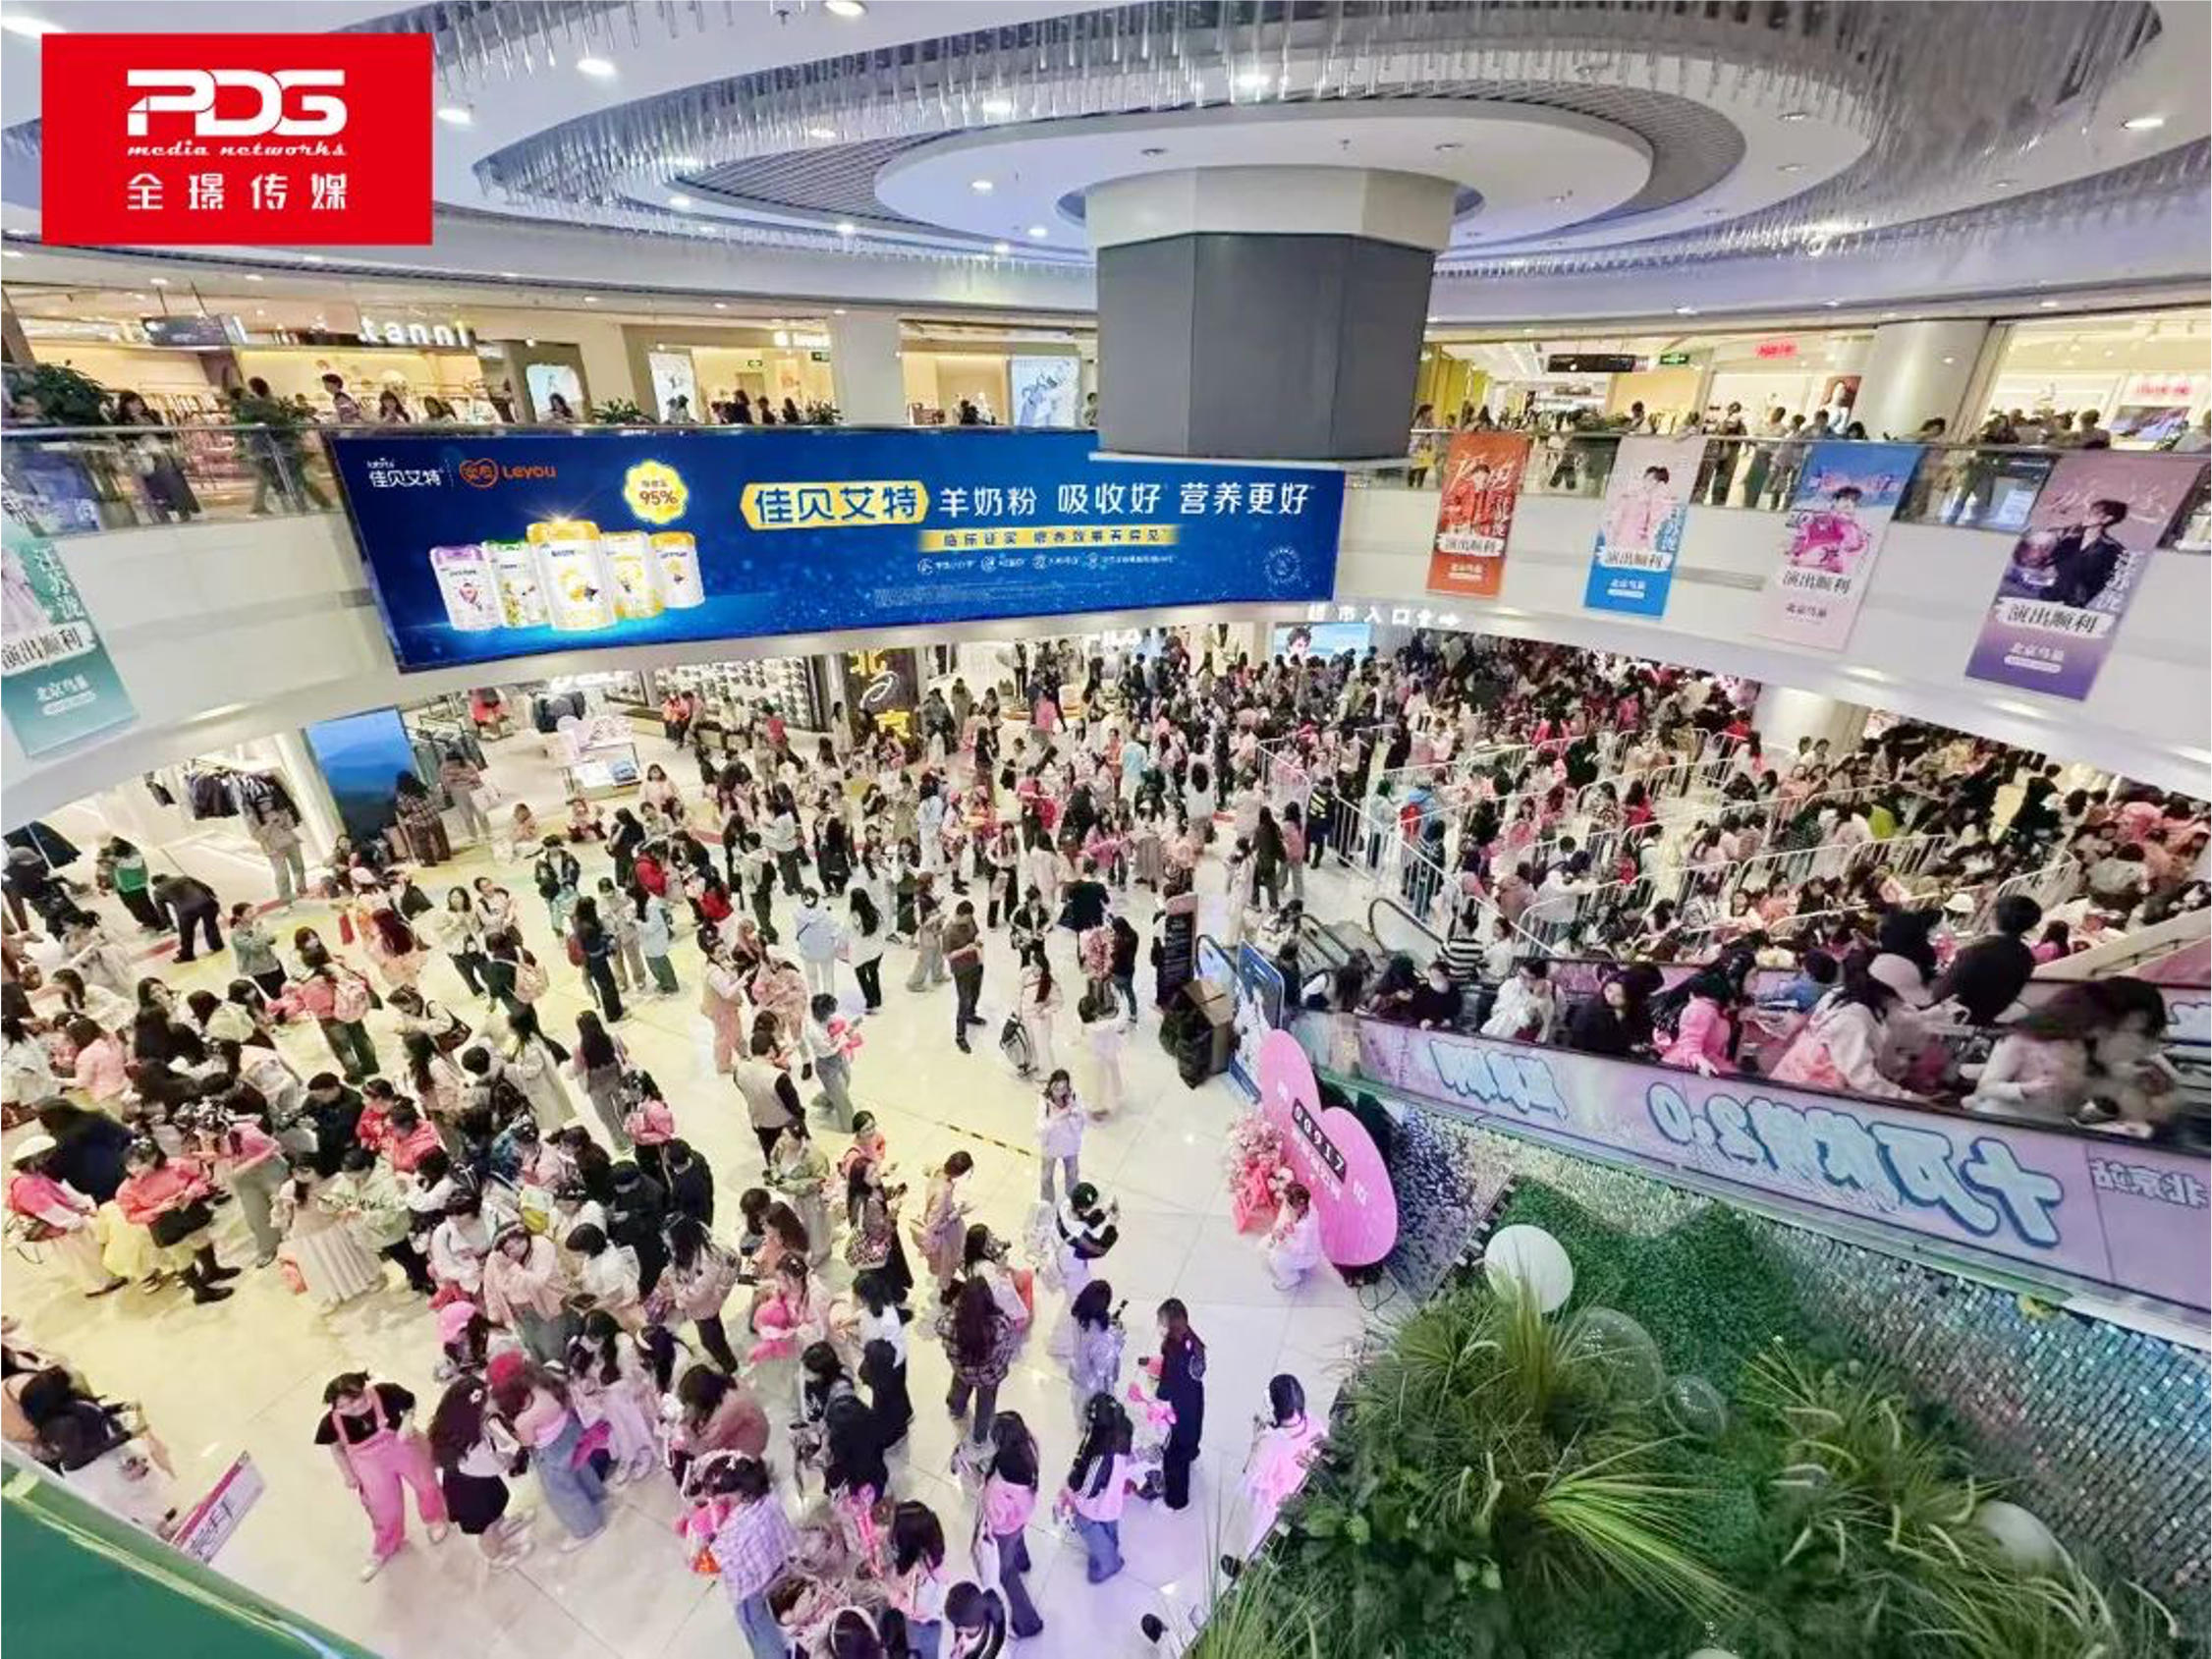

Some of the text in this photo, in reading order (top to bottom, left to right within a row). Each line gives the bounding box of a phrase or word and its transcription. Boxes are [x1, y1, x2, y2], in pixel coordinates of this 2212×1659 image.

[369, 470, 442, 488] 佳贝艾特
[638, 490, 679, 507] 95%
[754, 480, 1311, 524] 佳贝艾特 羊奶粉 吸收好 营养更好
[2007, 603, 2100, 635] 演出顺利
